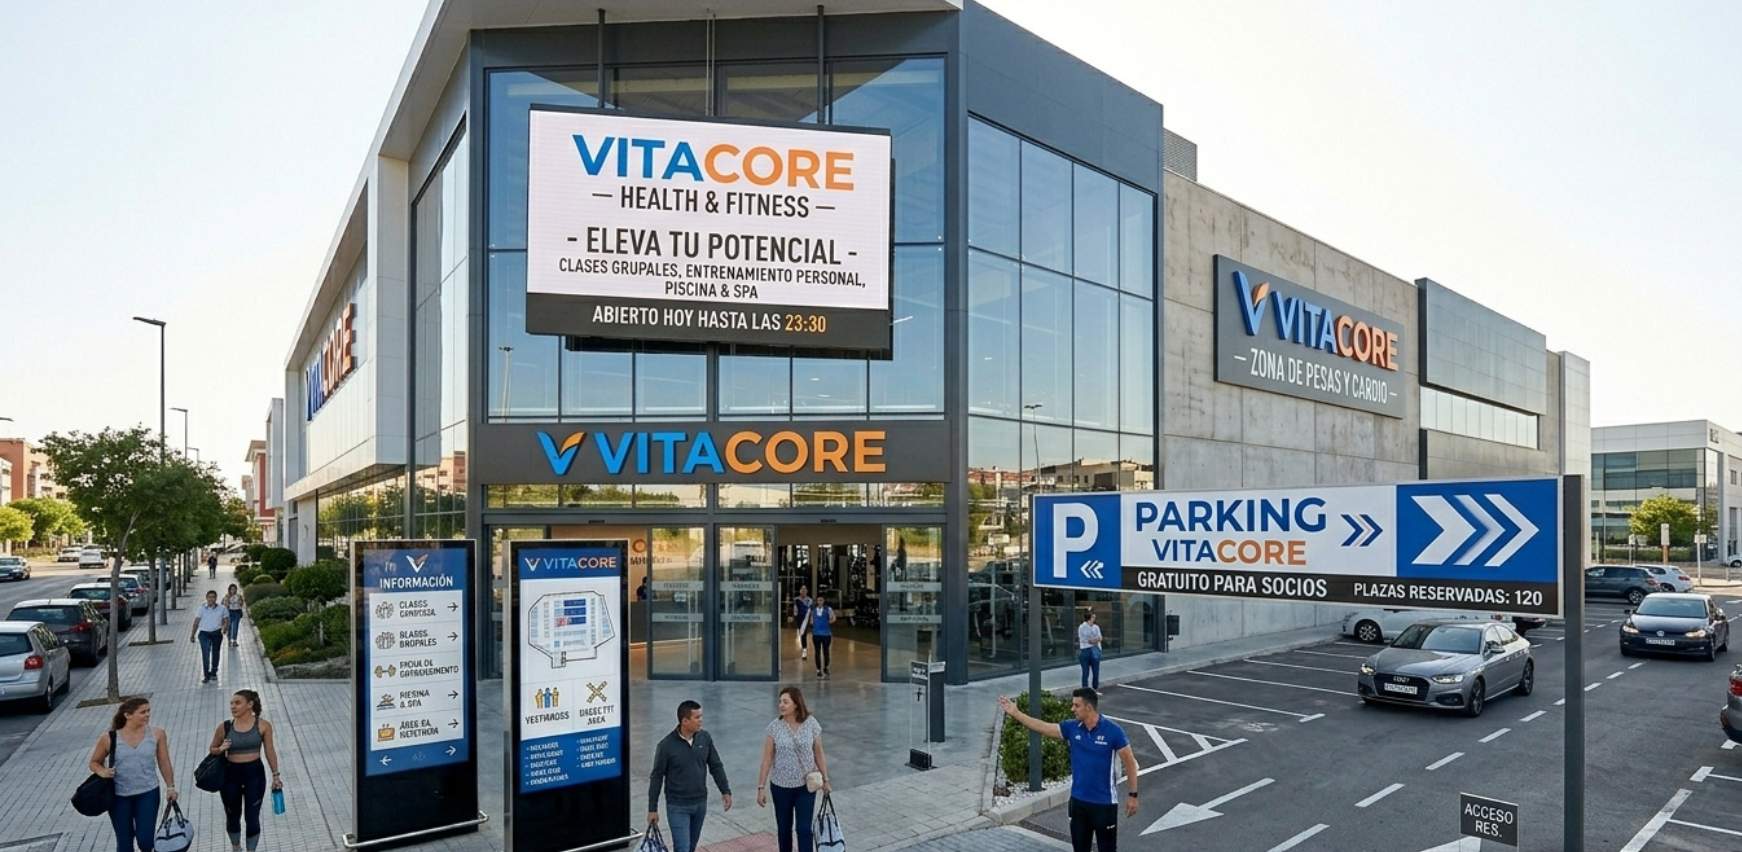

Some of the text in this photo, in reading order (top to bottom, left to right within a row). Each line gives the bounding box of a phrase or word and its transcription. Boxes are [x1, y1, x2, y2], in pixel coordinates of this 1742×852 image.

[571, 134, 855, 192] VITACORE
[620, 185, 810, 218] HEALTH & FITNESS
[587, 226, 842, 266] ELEVA TU POTENCIAL
[558, 257, 866, 289] CLASES GRUPALES, ENTRENAMIENTO PERSONAL,
[664, 281, 759, 300] PISCINA & SPA
[592, 305, 827, 334] ABIERTO HOY HASTA LAS 23:30
[1270, 290, 1400, 372] VITACORE
[1250, 348, 1388, 404] ZONA DE PESAS Y CARDIO
[594, 430, 887, 475] VITACORE
[1135, 496, 1327, 534] PARKING
[1053, 502, 1099, 580] P
[1152, 539, 1308, 567] VITACORE
[543, 556, 618, 571] VITACORE
[380, 574, 453, 590] INFORMACIÓN
[1137, 570, 1543, 607] GRATUITO PARA SOCIOS PLAZAS RESERVADAS: 120
[1463, 802, 1514, 826] ACCESO
[1474, 820, 1503, 838] RES.
